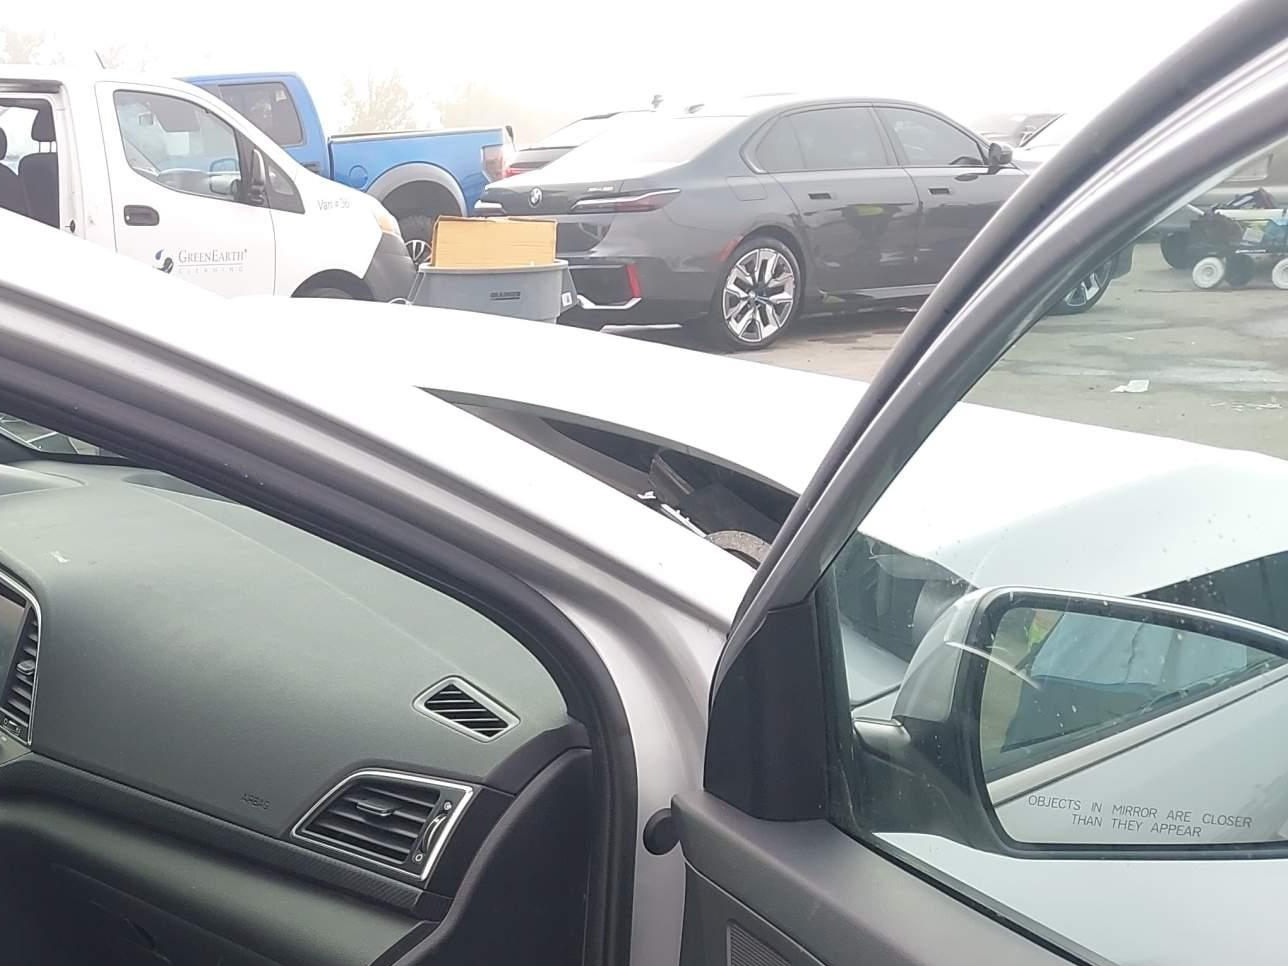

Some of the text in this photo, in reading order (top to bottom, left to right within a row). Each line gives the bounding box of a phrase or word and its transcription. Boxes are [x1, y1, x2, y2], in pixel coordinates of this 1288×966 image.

[1028, 795, 1253, 828] OBJECTS IN MIRROR ARE CLOSER
[1072, 814, 1202, 837] THAN THEY APPEAR
